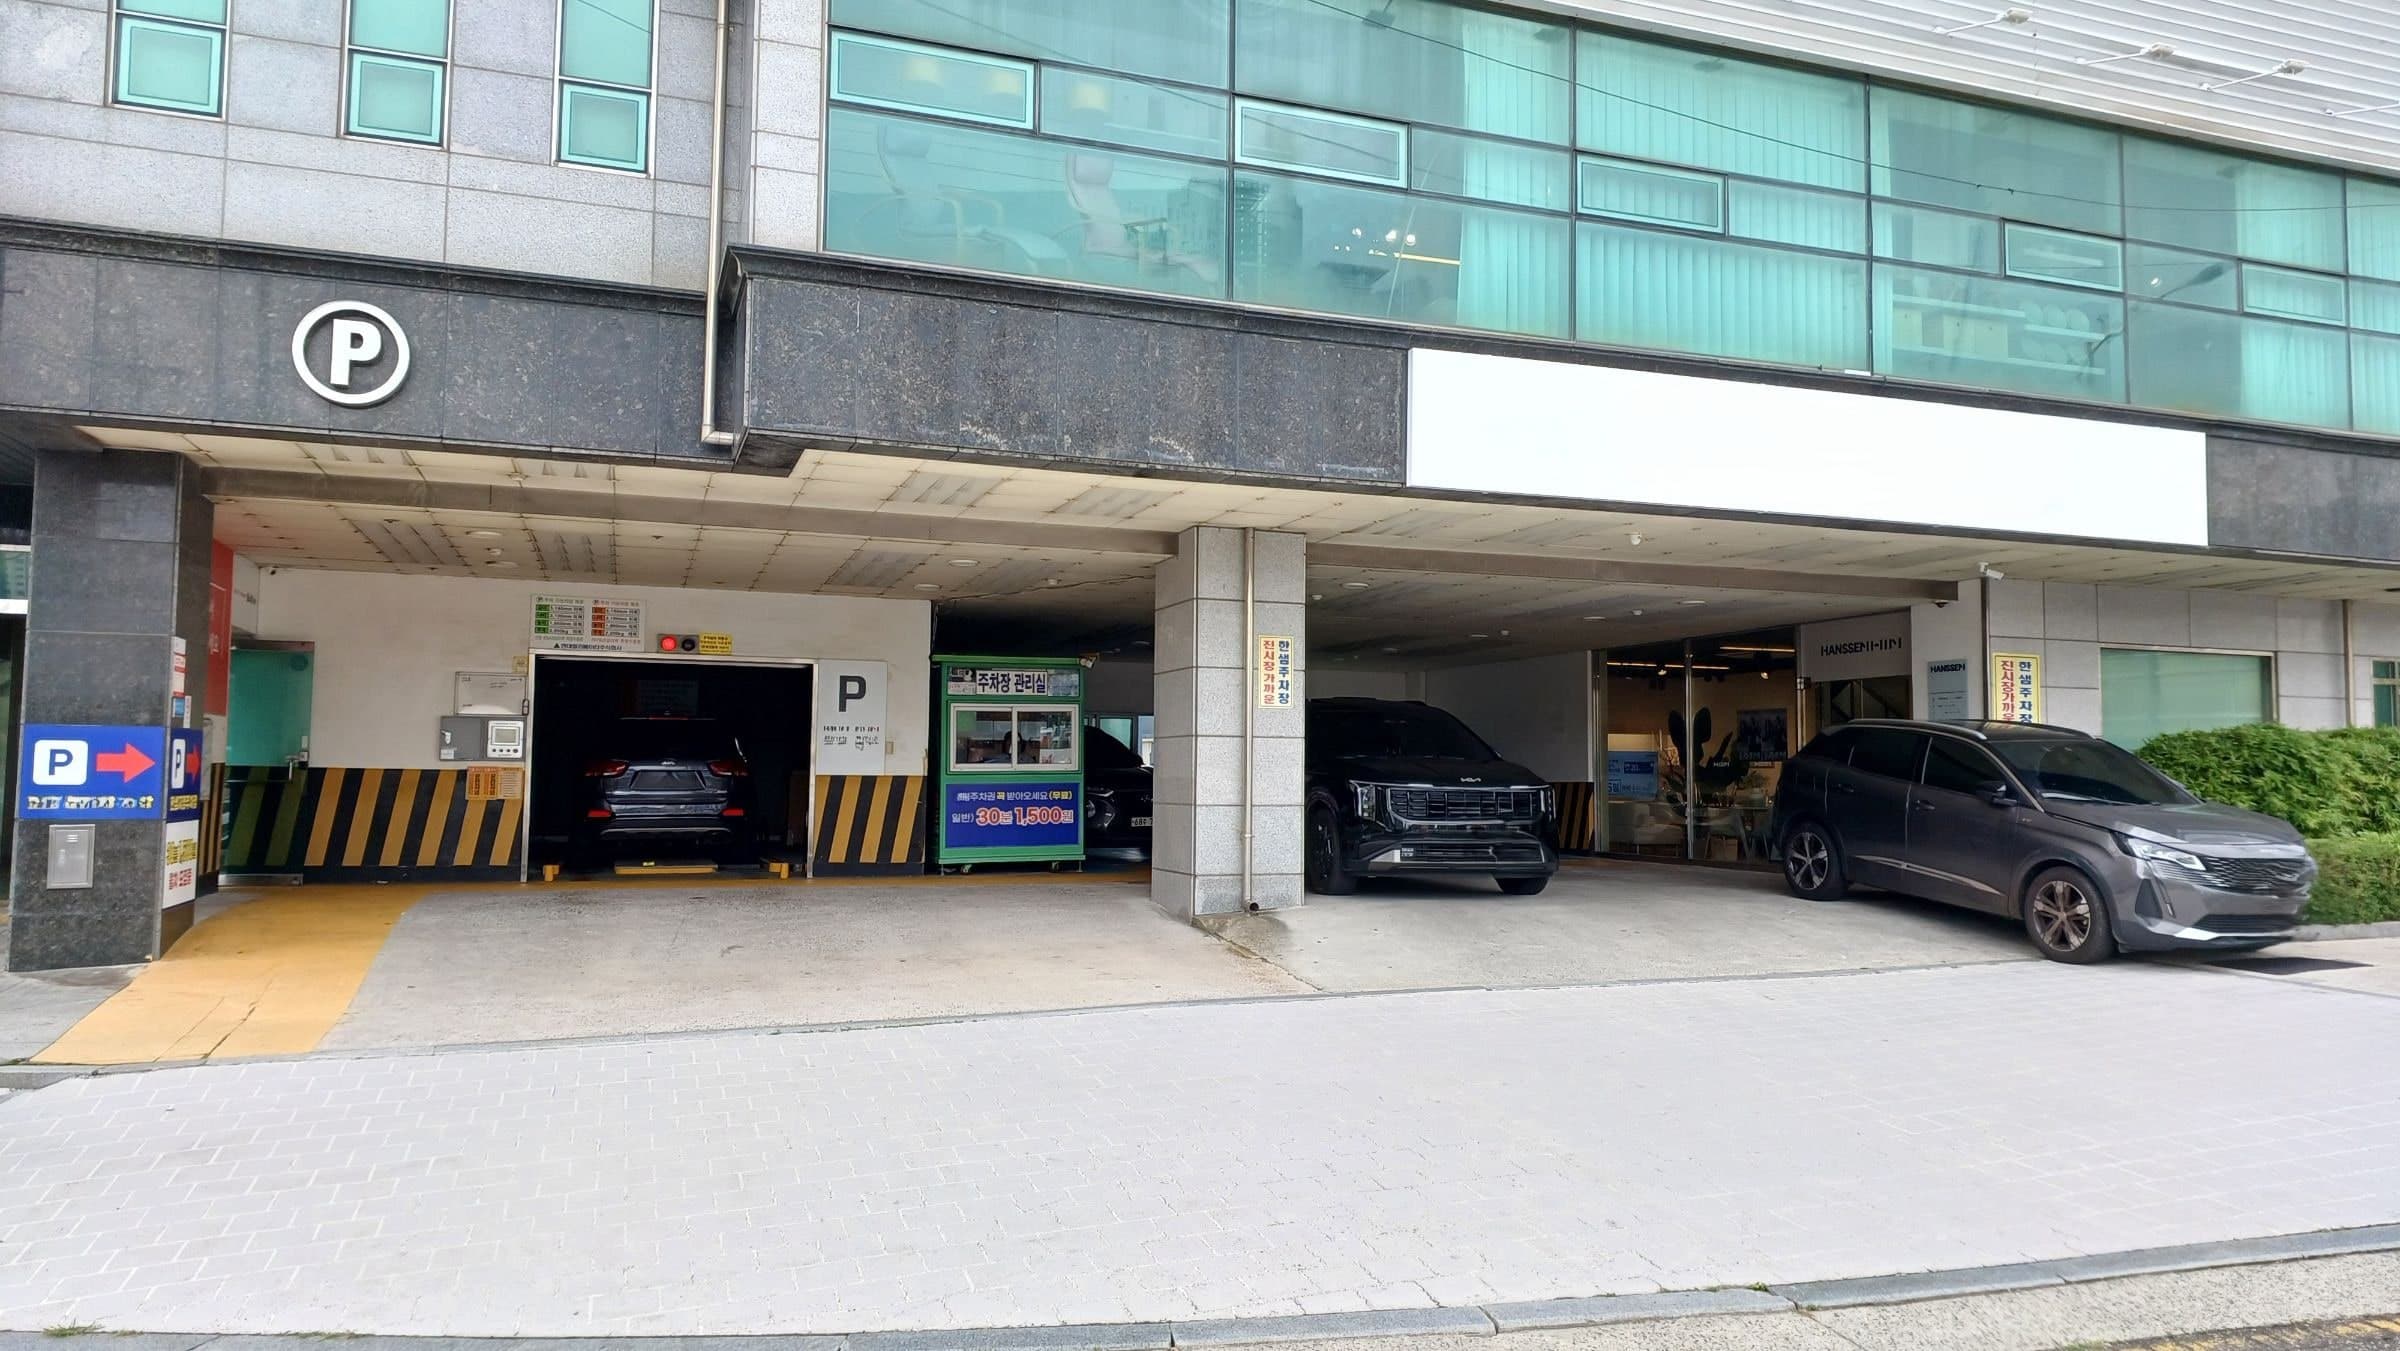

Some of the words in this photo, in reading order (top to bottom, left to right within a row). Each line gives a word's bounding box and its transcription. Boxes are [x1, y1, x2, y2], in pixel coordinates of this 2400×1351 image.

[330, 318, 382, 386] P
[838, 675, 867, 713] P
[978, 672, 1011, 693] 주차장
[1014, 672, 1046, 694] 관리실
[48, 748, 74, 776] P
[975, 807, 1012, 826] 30분
[1014, 806, 1074, 826] 1,500원
